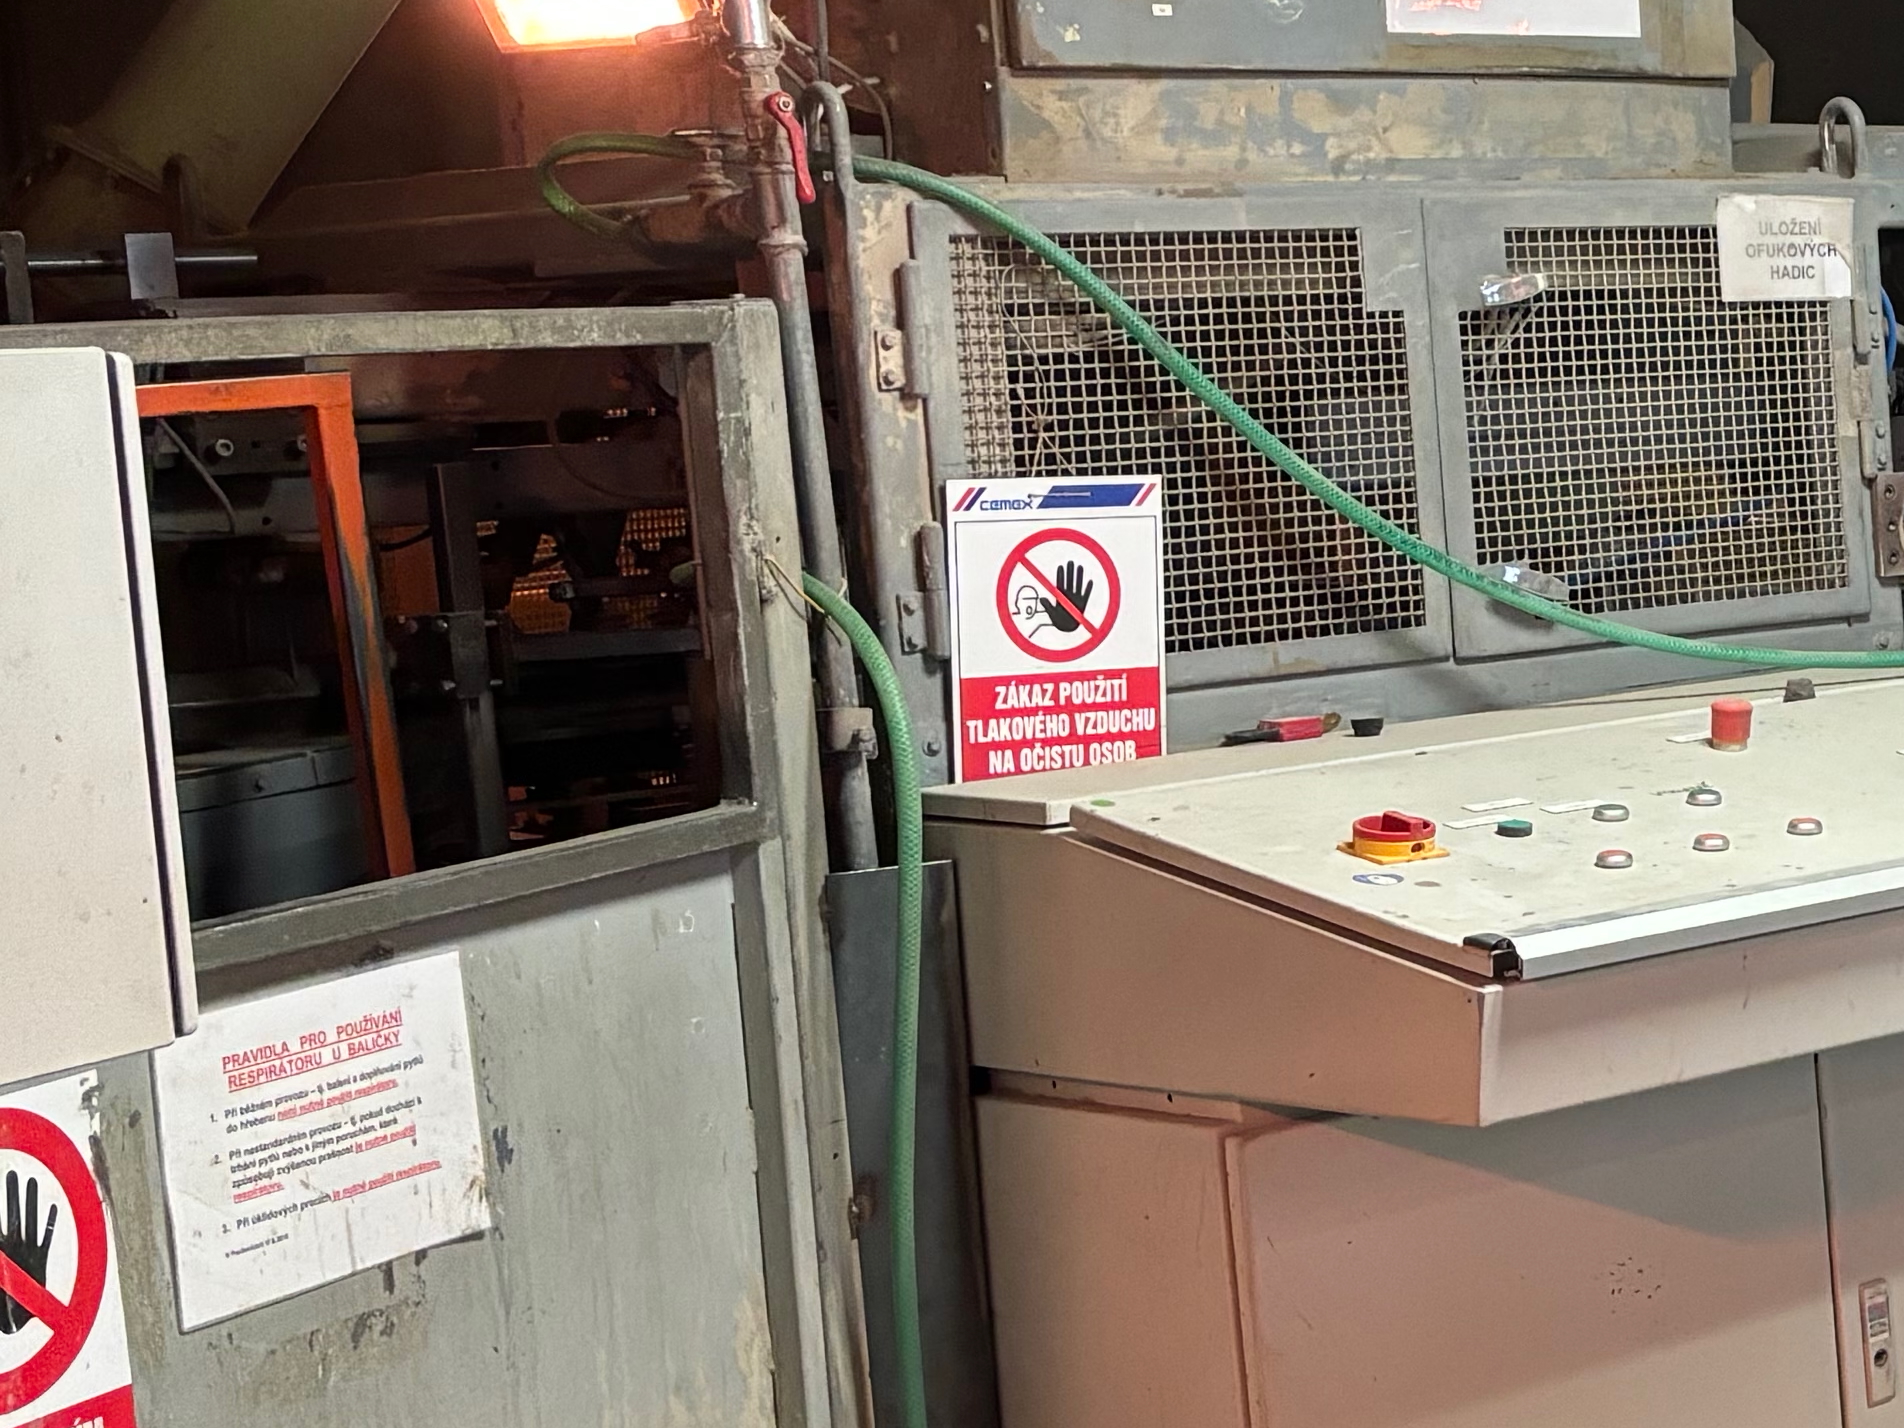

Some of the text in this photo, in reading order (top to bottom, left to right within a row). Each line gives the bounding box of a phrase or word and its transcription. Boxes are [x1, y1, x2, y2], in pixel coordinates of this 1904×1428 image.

[1759, 217, 1822, 236] ULOŽENÍ
[1745, 239, 1838, 259] OFUKOVÝCH
[1770, 265, 1815, 280] HADIC
[994, 674, 1127, 710] ZÁKAZ POUŽITÍ
[966, 707, 1156, 744] TLAKOVÉHO VZDUCHU
[988, 739, 1137, 774] NA OČISTU OSOB
[222, 1007, 402, 1071] PRAVIDLA PRO POUŽÍVÁNÍ
[228, 1028, 401, 1090] RESPIRÁTORU U BALIČKY
